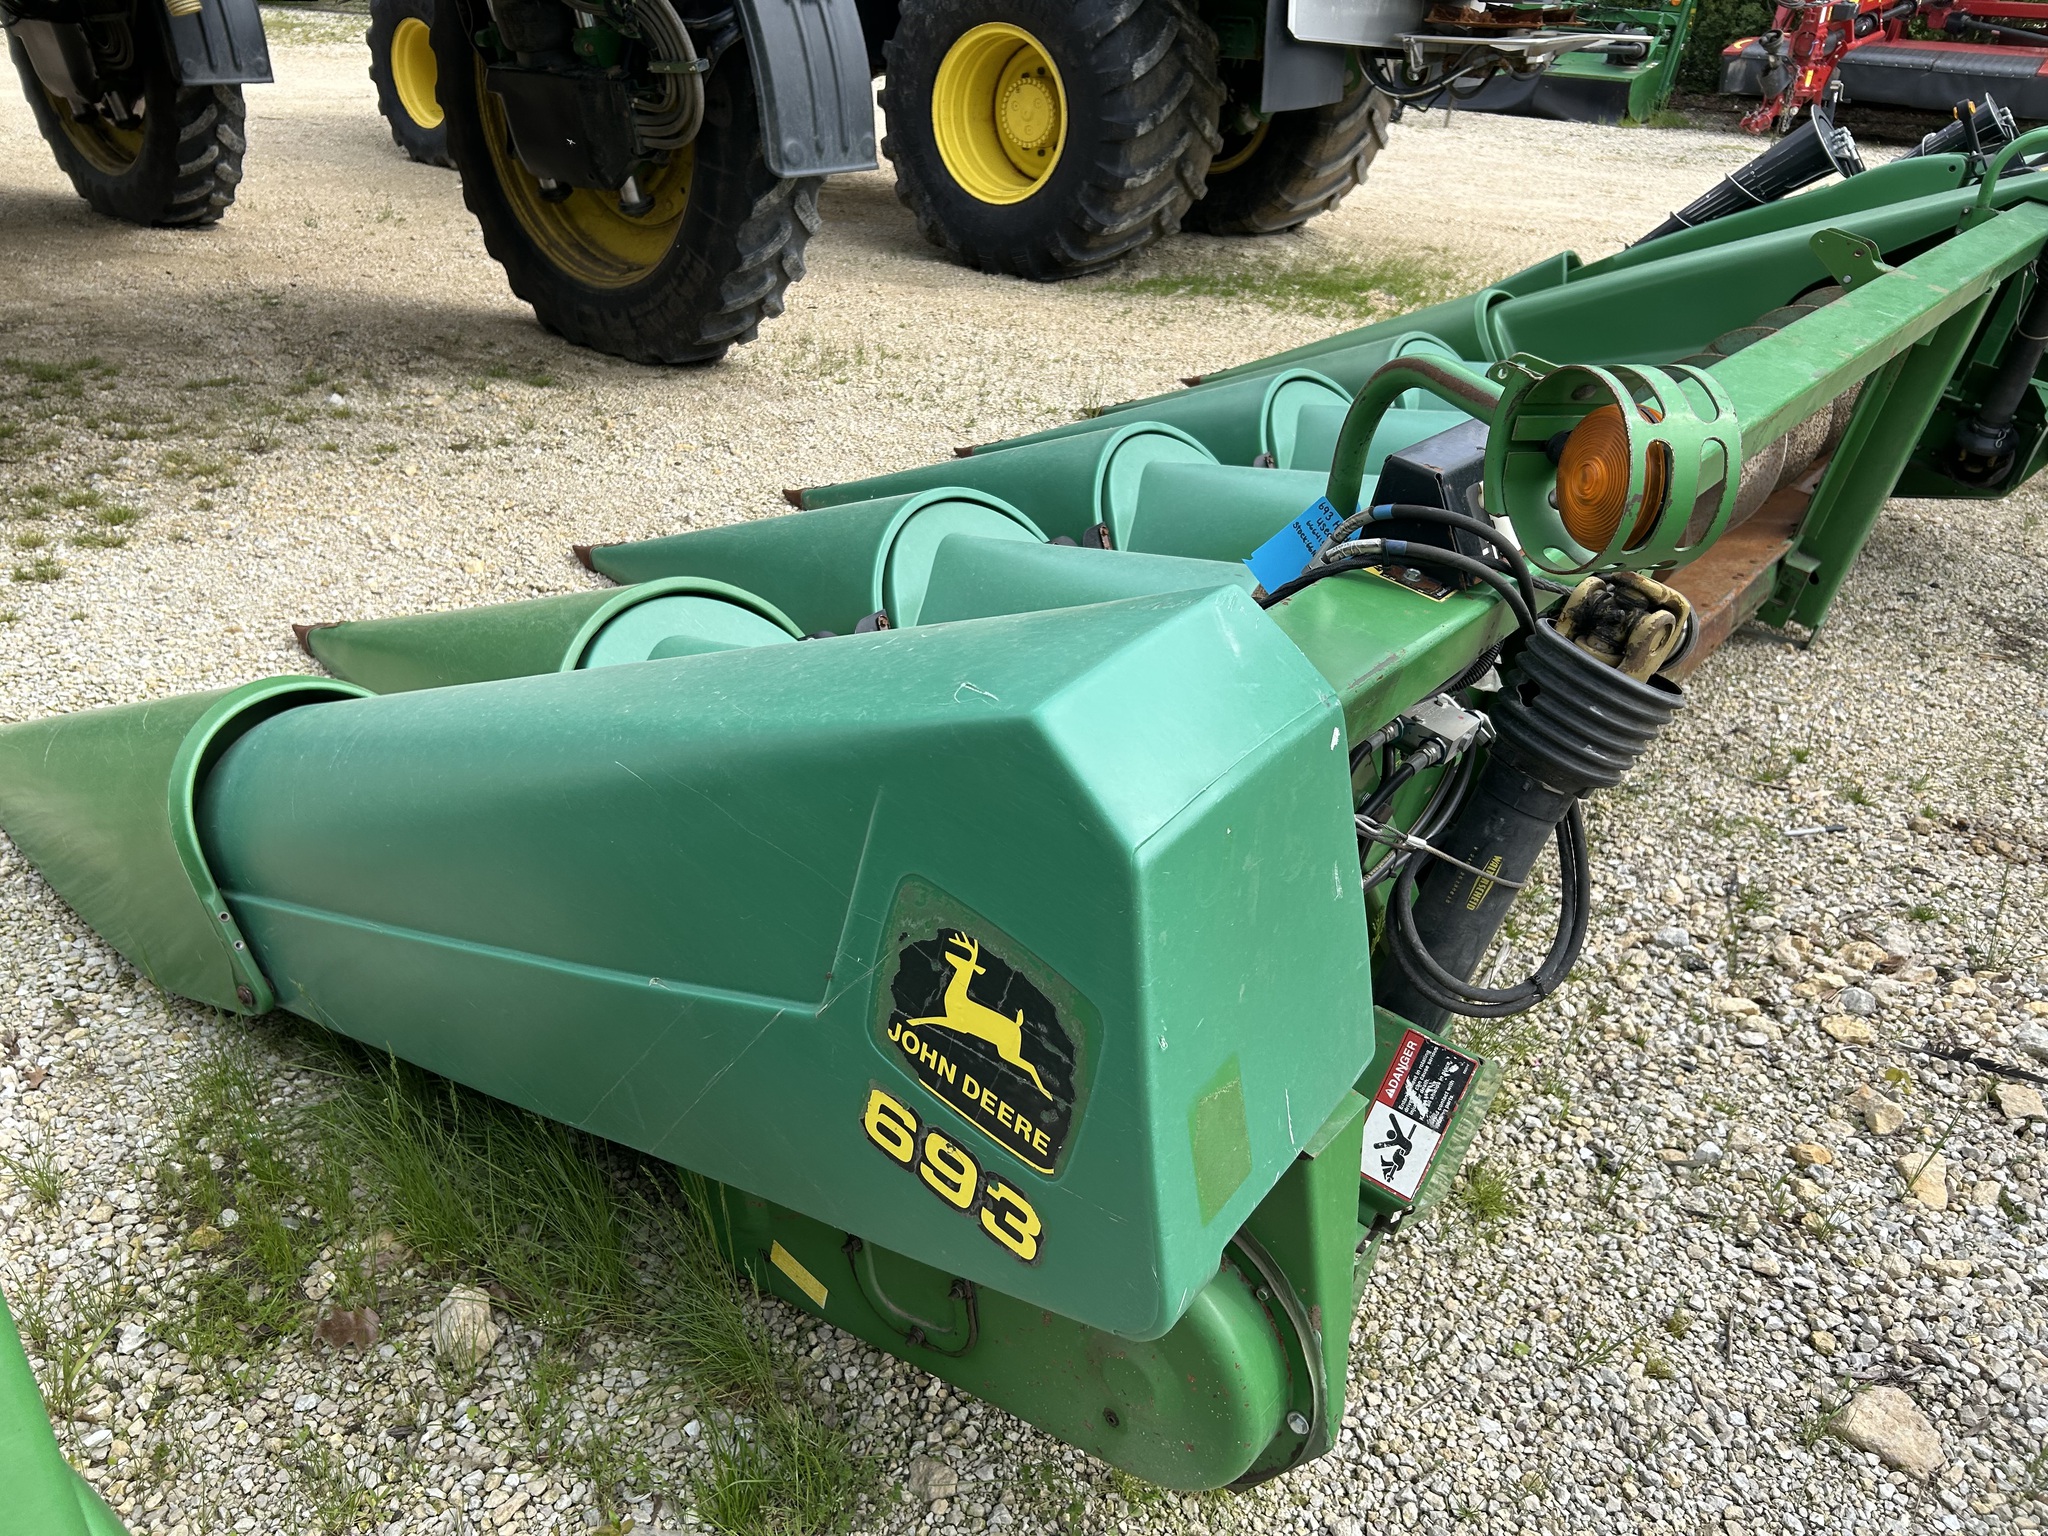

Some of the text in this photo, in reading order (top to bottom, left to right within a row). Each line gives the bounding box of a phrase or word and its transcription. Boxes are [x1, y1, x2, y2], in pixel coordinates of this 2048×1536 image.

[1318, 501, 1334, 521] 693
[1466, 855, 1503, 910] WALTRSCHEID
[887, 1023, 1052, 1156] JOHN DEERE
[1390, 1040, 1418, 1086] DANGER
[864, 1088, 1042, 1262] 693
